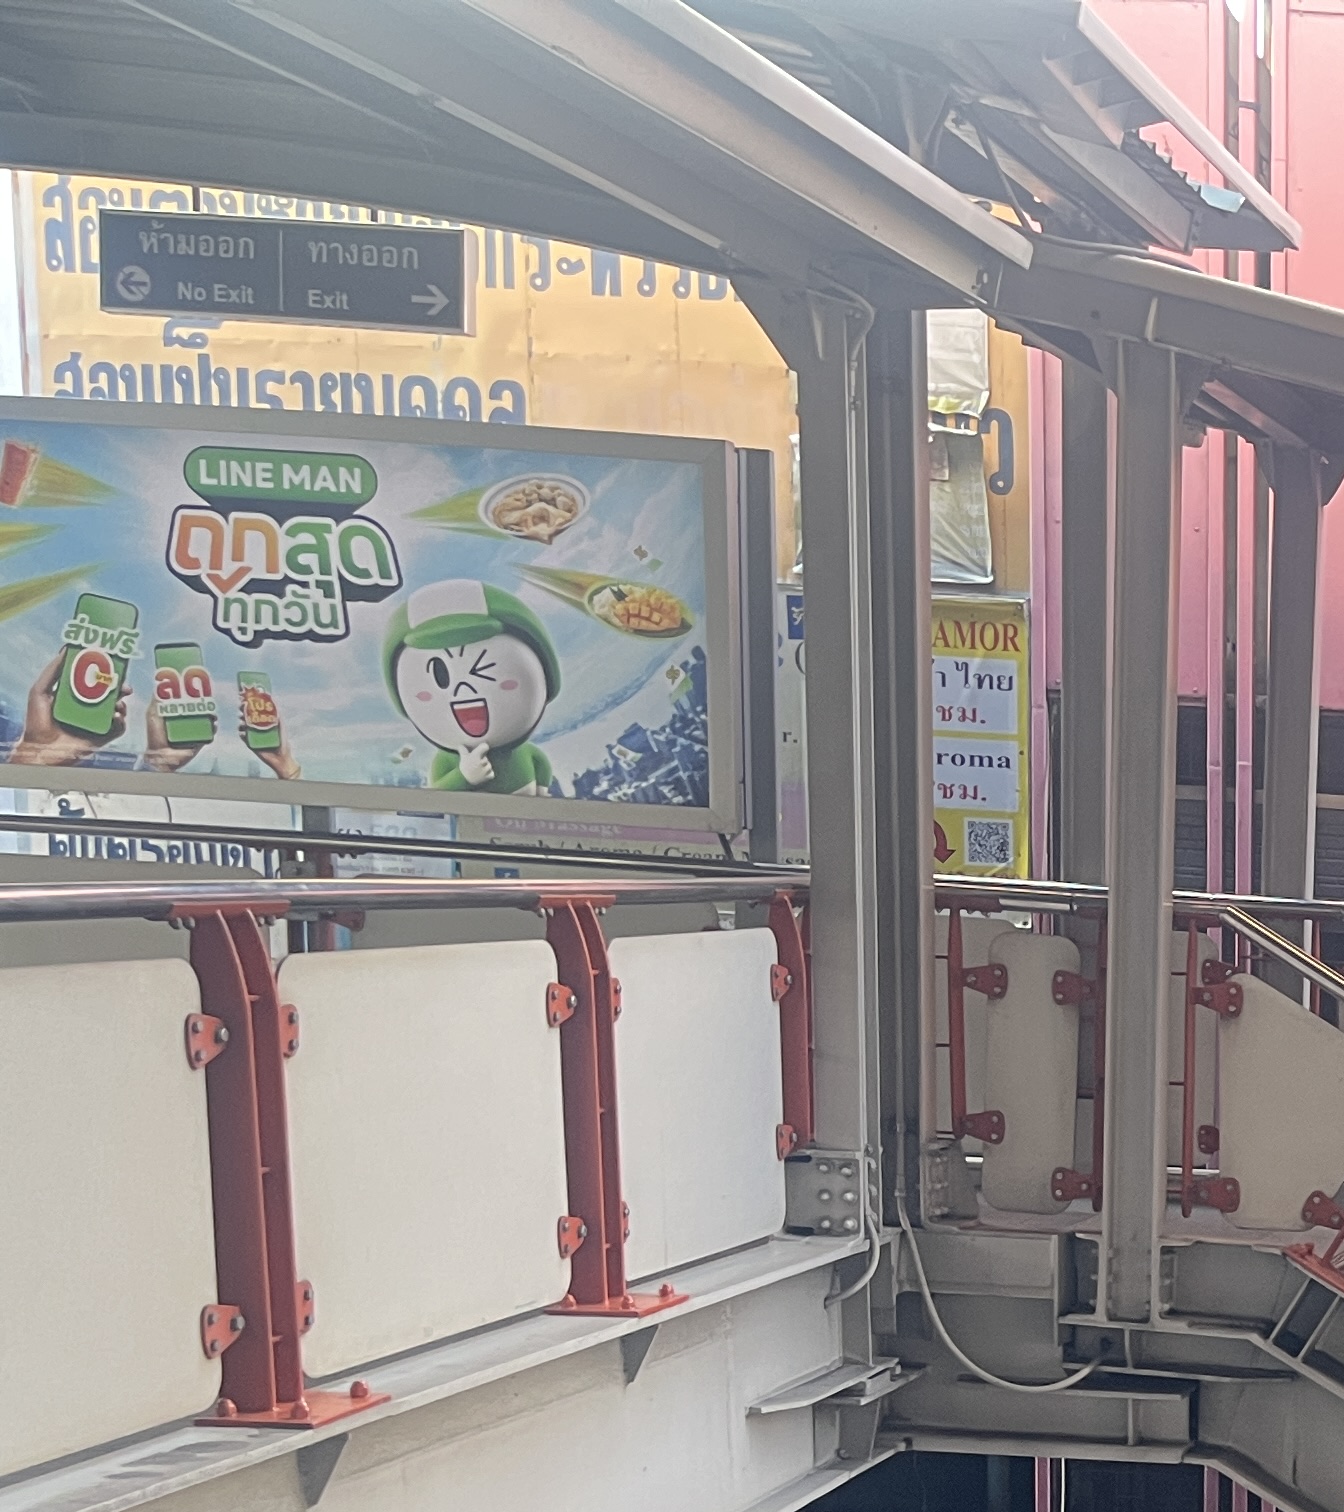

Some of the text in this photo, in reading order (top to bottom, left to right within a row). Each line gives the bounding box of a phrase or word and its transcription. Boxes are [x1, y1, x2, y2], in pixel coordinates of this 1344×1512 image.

[138, 220, 254, 260] ห้ามออก
[308, 238, 420, 270] ทางออก
[177, 282, 254, 305] No Exit
[308, 290, 349, 310] Exit
[199, 458, 362, 494] LINE MAN
[175, 514, 394, 600] ถูกสุด
[222, 588, 340, 637] ทุกวัน
[64, 616, 141, 656] ส่งฟรี
[932, 619, 1022, 653] AMOR
[155, 668, 213, 699] ลด
[954, 662, 1014, 692] ไทย
[935, 751, 1012, 770] roma
